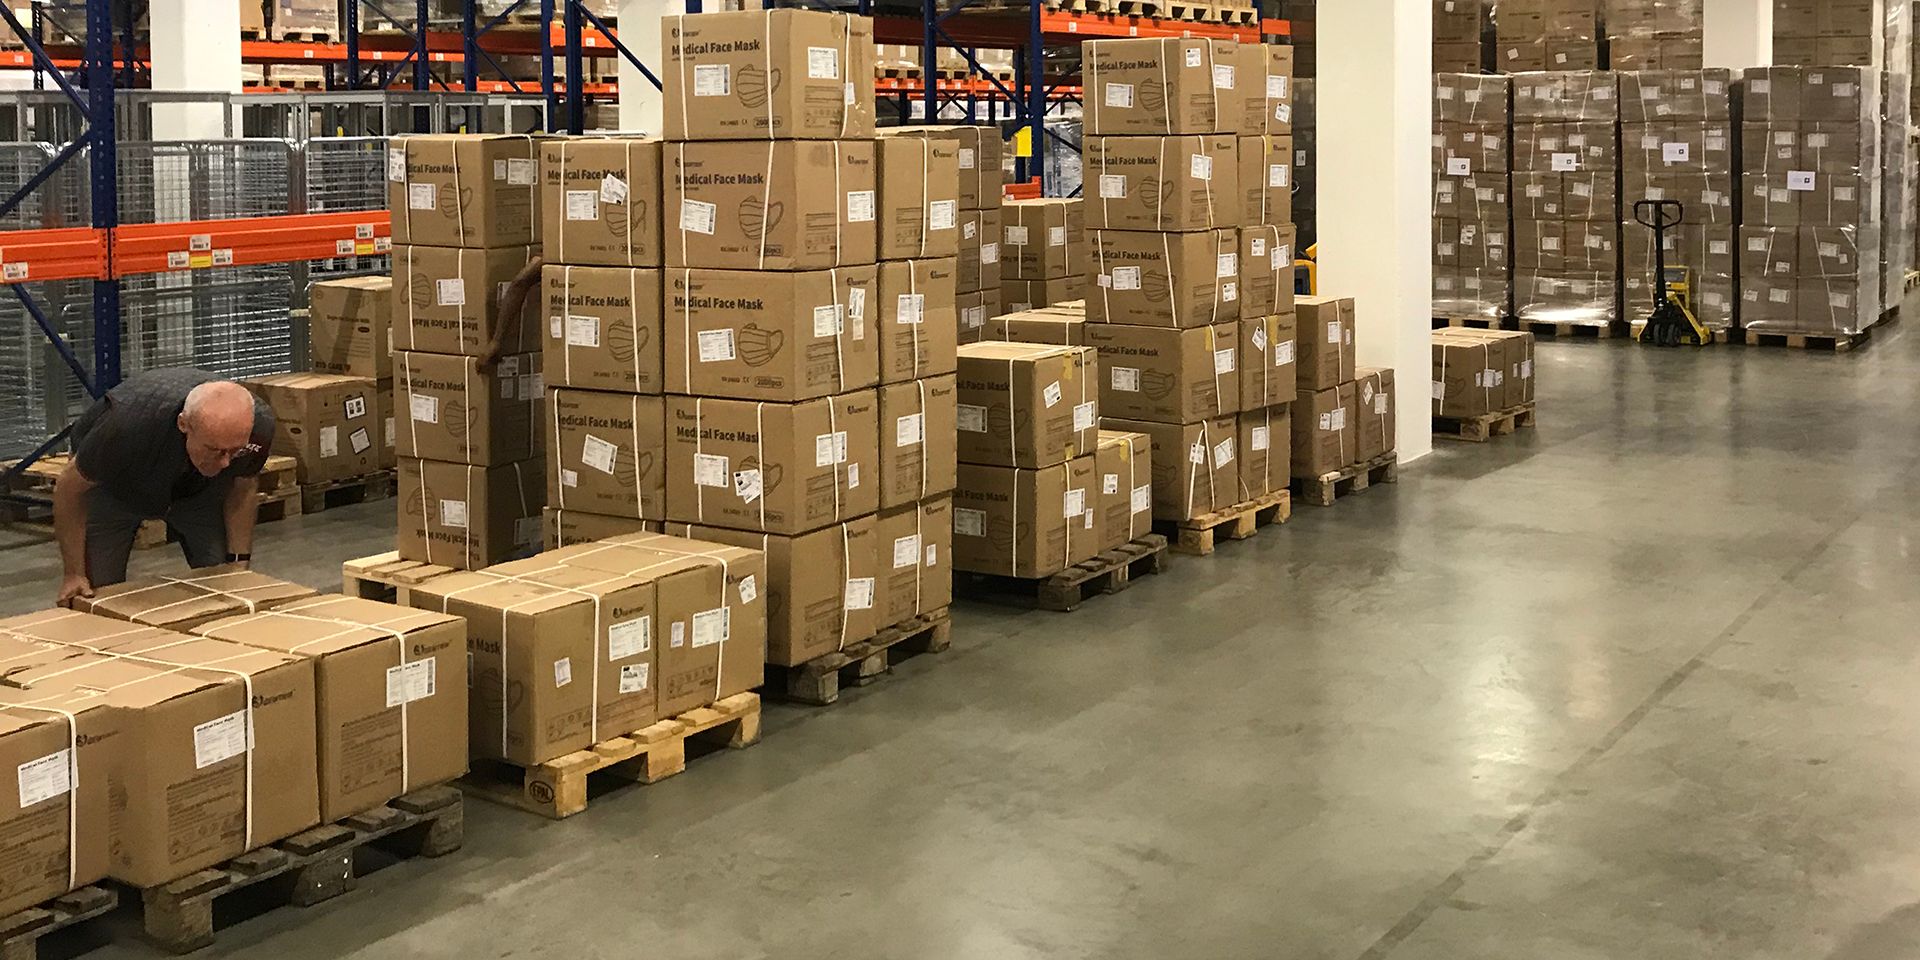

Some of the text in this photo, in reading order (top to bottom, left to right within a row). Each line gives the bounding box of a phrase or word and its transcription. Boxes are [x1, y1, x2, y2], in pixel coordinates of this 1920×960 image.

[672, 39, 760, 55] Mdical Face Mask
[1119, 61, 1136, 70] Face
[1137, 60, 1158, 69] Mask
[1090, 156, 1157, 165] Meical Face Mask
[425, 164, 441, 173] Face
[548, 169, 580, 180] Meical
[581, 169, 601, 180] Face
[714, 173, 736, 185] Face
[738, 173, 764, 185] Mask
[1092, 250, 1160, 260] Mdical Face Mask
[551, 295, 631, 307] Meical Face Mask
[713, 298, 736, 309] Face
[737, 299, 763, 310] Mask
[1097, 346, 1159, 356] edical Face Mask
[401, 377, 427, 388] Mdical
[428, 379, 446, 390] Face
[558, 414, 633, 430] edical Face Mask
[677, 426, 712, 440] Medcal
[714, 429, 736, 441] Face
[416, 528, 433, 540] Msk
[475, 638, 501, 655] Mask
